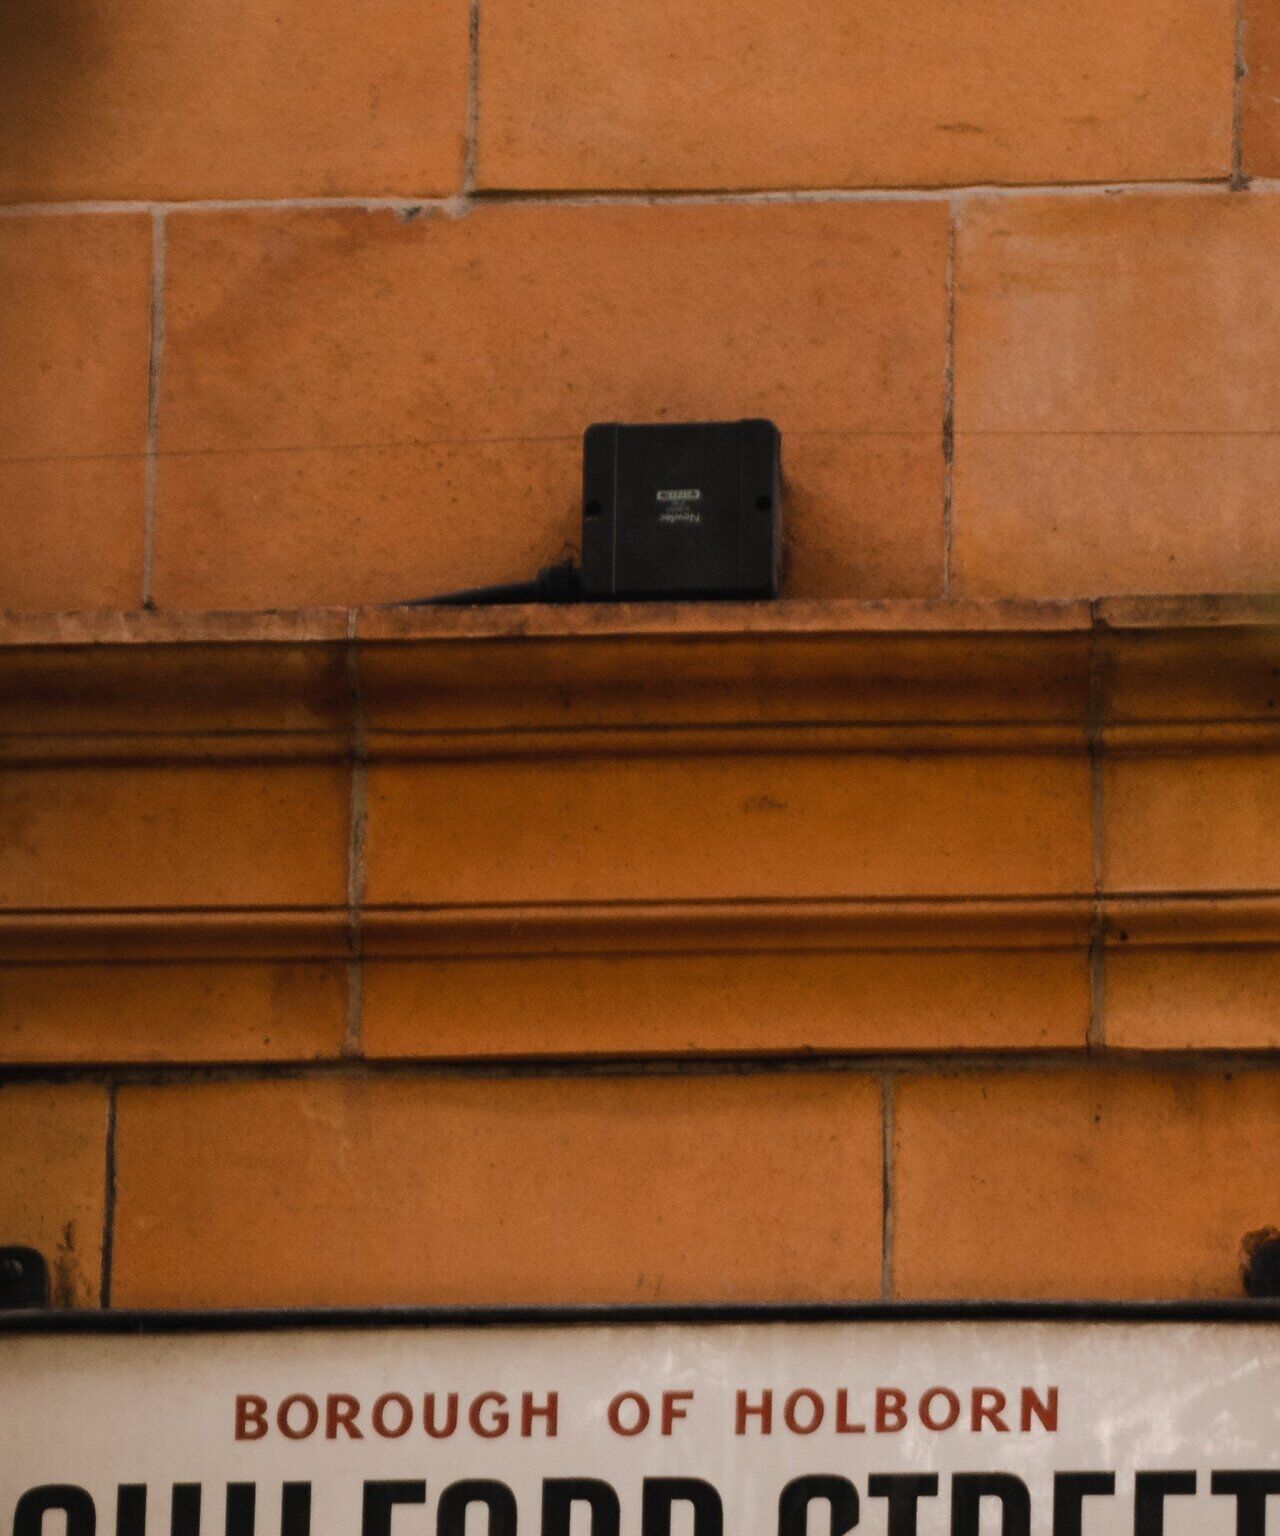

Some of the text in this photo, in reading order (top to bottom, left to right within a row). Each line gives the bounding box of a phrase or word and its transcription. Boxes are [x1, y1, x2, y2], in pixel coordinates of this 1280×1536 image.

[234, 1386, 1060, 1442] BOROUGH OF HOLBORN
